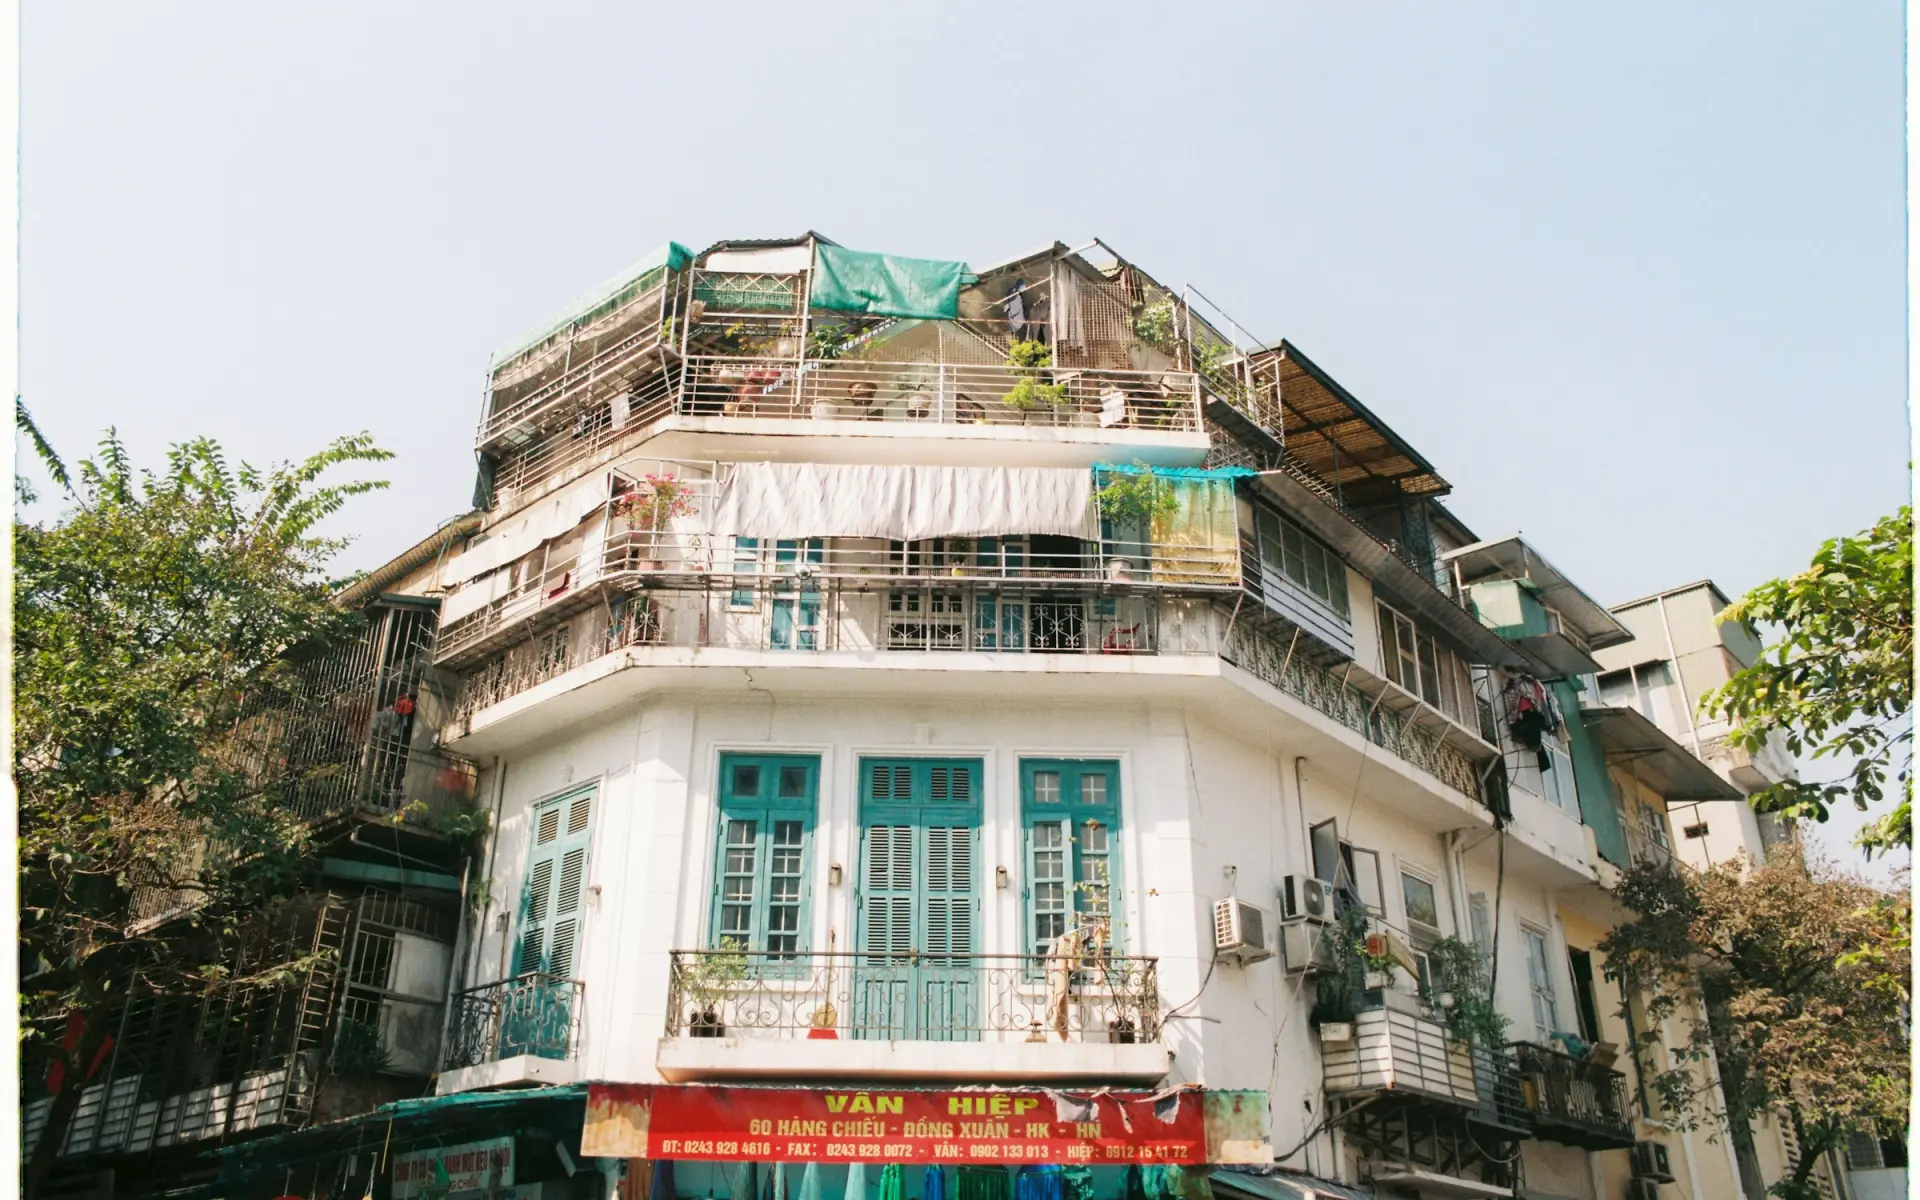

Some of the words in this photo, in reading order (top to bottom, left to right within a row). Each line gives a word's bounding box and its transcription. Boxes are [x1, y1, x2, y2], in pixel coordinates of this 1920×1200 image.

[825, 1091, 904, 1114] VÂN
[948, 1093, 1039, 1119] HIỆP
[750, 1119, 772, 1136] 60
[777, 1115, 827, 1137] HÀNG
[832, 1116, 885, 1137] CHIẾU
[959, 1119, 1009, 1139] XUÂN
[1026, 1122, 1049, 1138] HK
[1076, 1123, 1101, 1139] HN
[662, 1140, 681, 1153] ĐT:
